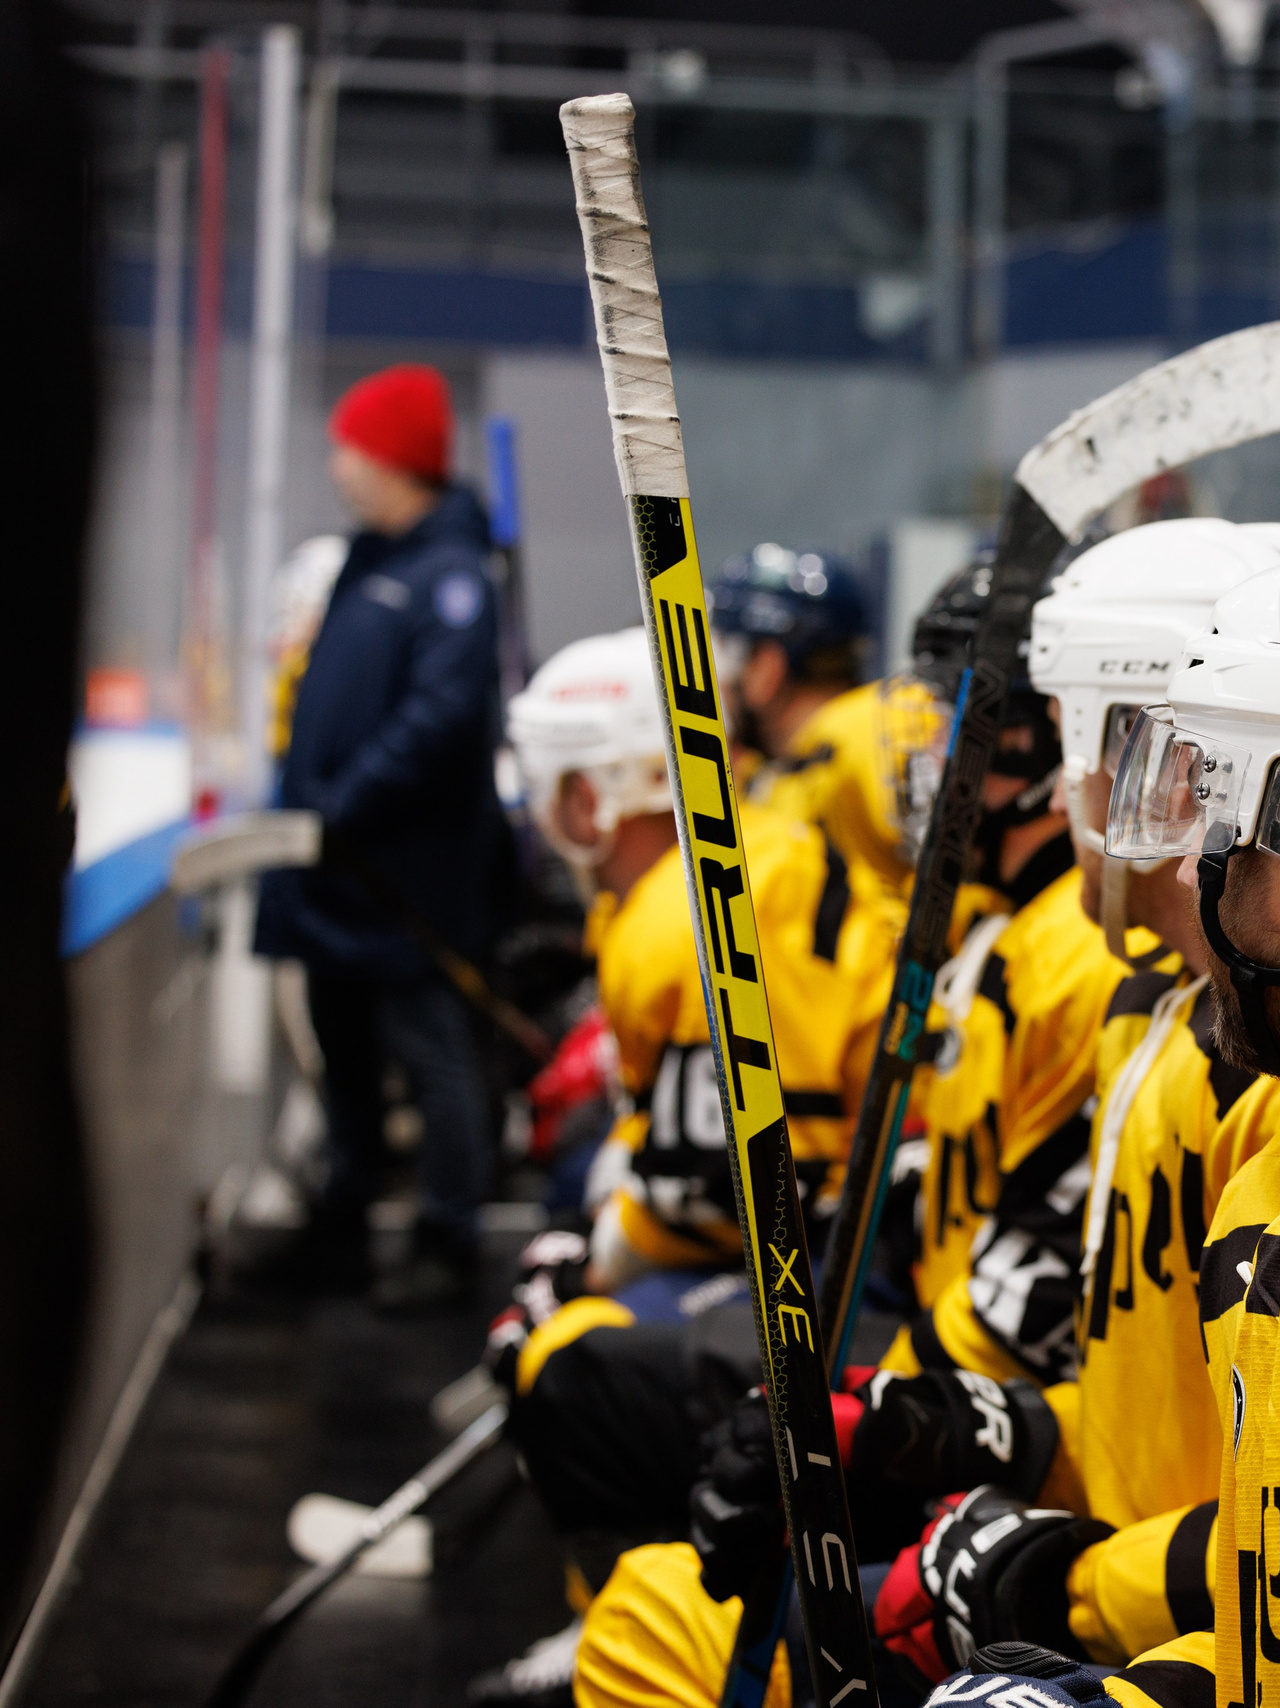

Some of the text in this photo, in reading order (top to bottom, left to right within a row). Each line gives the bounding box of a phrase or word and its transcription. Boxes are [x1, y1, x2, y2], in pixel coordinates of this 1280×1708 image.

[1099, 658, 1171, 676] CCM
[659, 599, 772, 1111] TRUE
[767, 1243, 814, 1353] 3X
